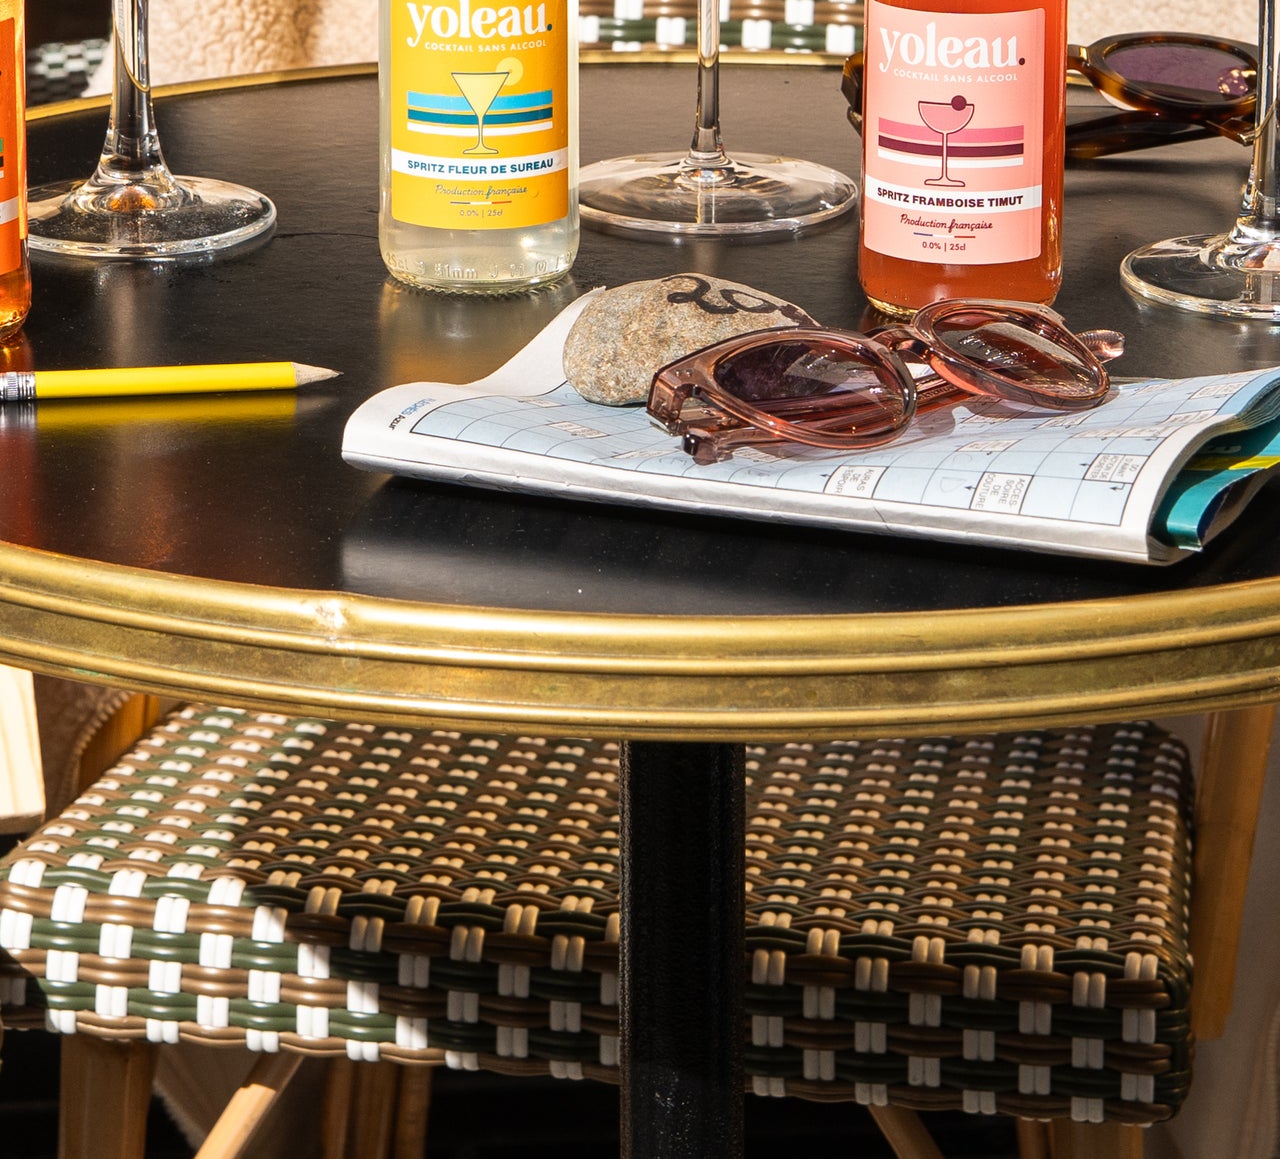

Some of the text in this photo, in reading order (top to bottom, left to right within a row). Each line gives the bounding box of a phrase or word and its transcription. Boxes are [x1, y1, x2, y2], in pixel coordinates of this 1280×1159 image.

[424, 39, 547, 53] COCKTAIL SANS ALCOOL
[893, 67, 1018, 83] COCKTAIL SANS ALCOOL
[407, 157, 554, 175] SPRITZ FLEUR DE SUREAU
[435, 184, 528, 199] Production française
[877, 186, 1024, 208] SPRITZ FRAMBOISE TIMUT
[459, 208, 504, 218] 0.0% 25cl
[900, 213, 994, 232] Production française
[921, 241, 966, 251] 0.0% 25cl
[990, 484, 1002, 497] DE
